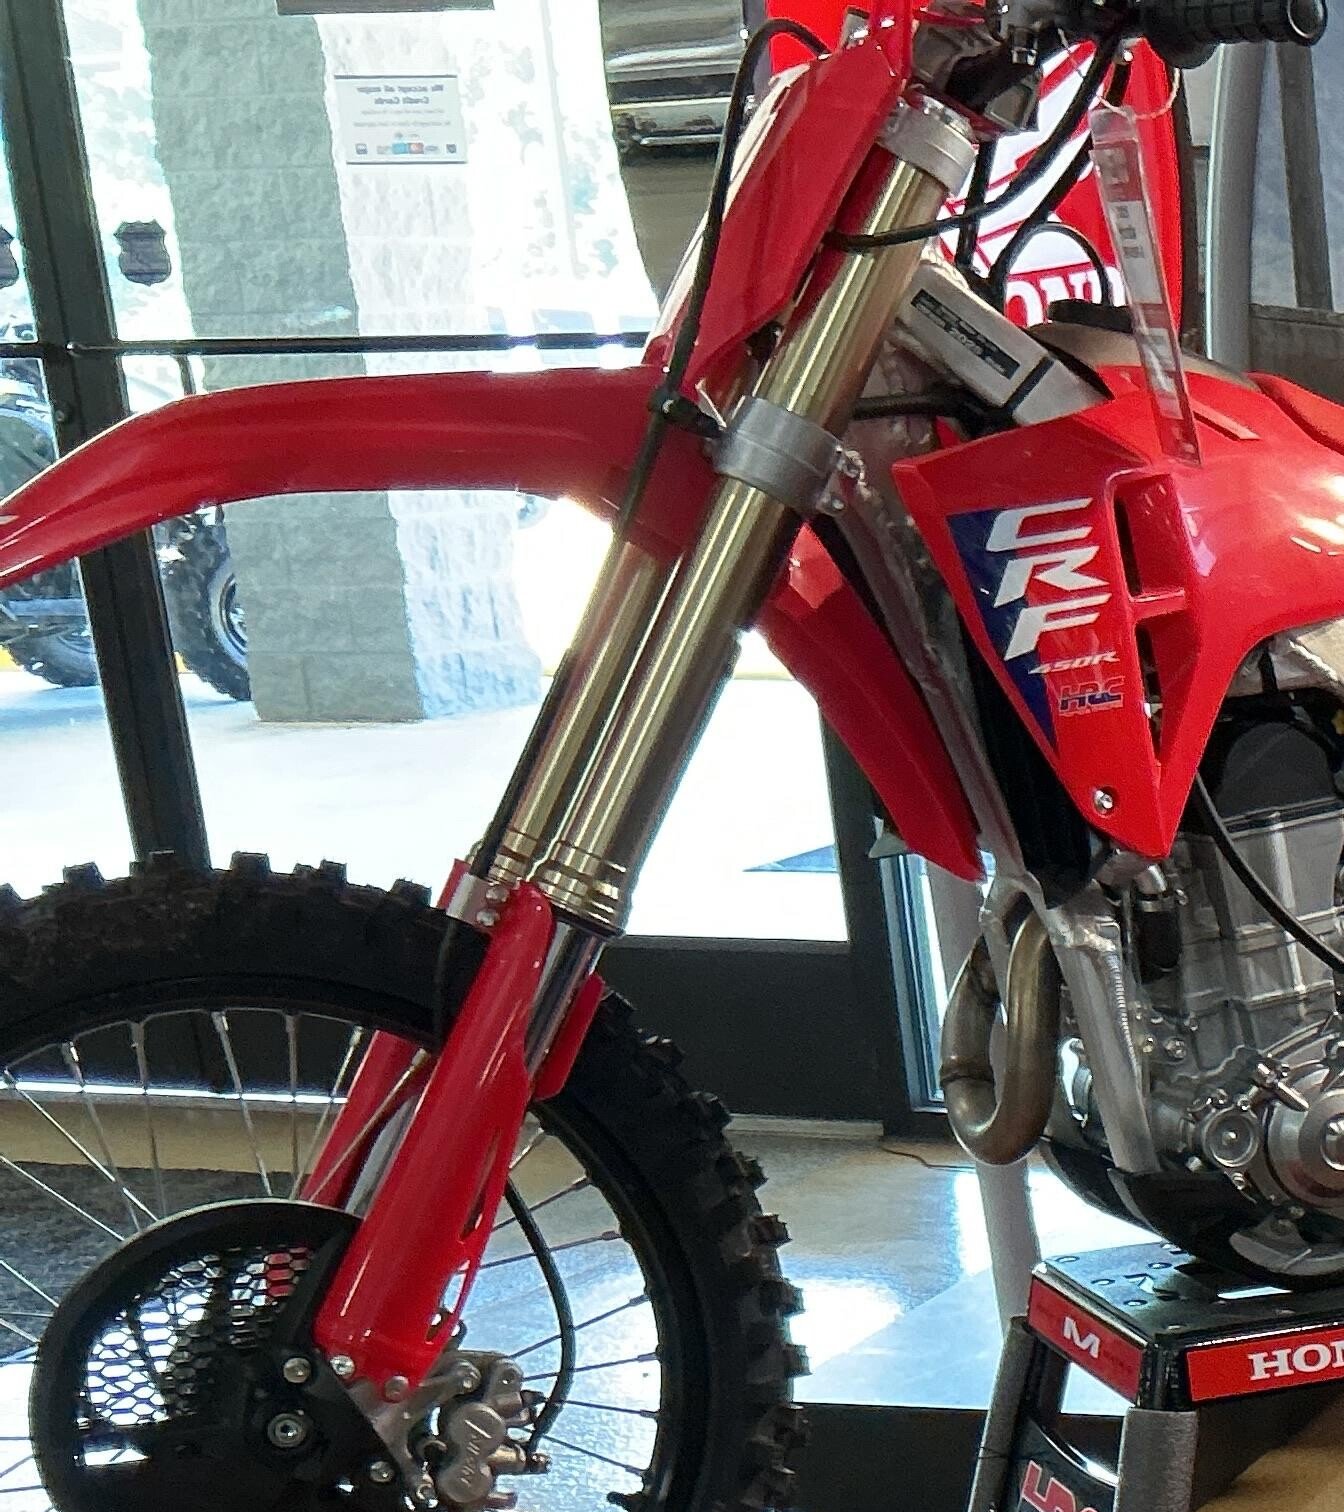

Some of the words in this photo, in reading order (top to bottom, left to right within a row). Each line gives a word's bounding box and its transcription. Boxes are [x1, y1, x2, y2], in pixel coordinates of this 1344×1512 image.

[985, 497, 1112, 661] CRF
[1028, 650, 1121, 675] 450R
[1059, 676, 1125, 711] HRC
